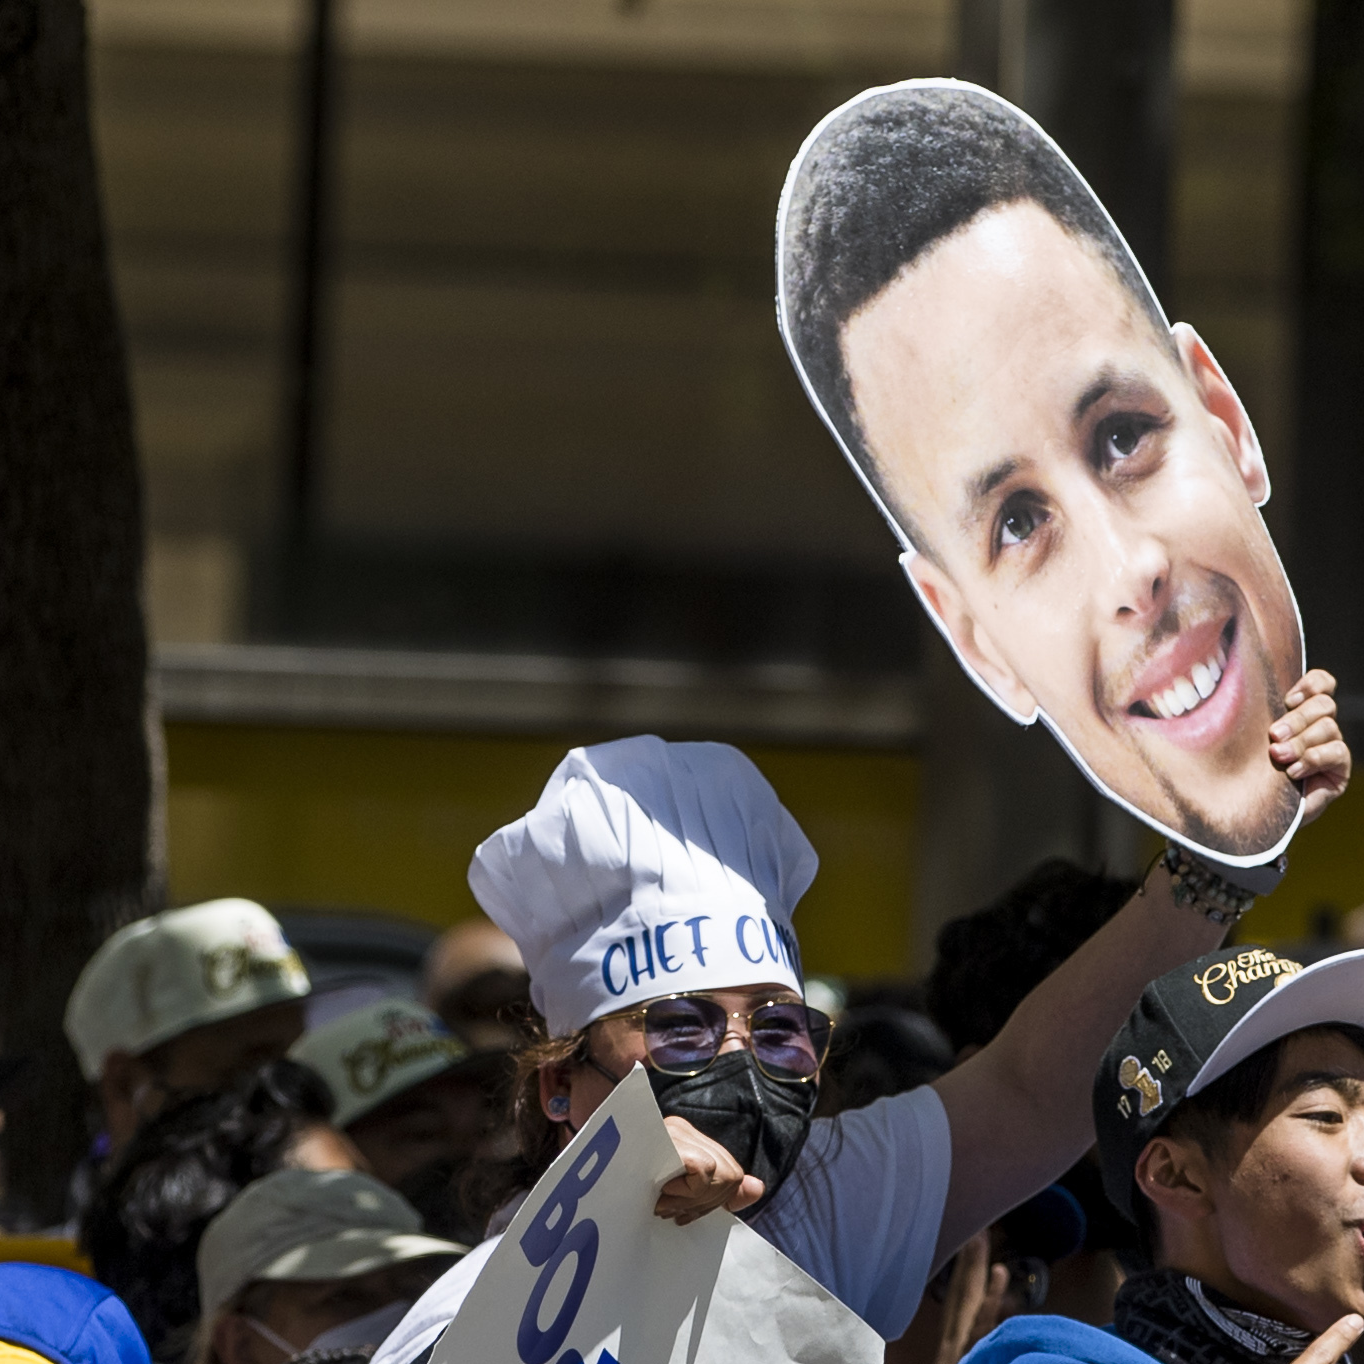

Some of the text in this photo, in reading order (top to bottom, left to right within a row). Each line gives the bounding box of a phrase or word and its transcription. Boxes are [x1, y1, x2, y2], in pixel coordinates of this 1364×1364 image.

[601, 915, 712, 996] CHEF
[1237, 949, 1277, 968] The
[1117, 1049, 1172, 1119] 17 18
